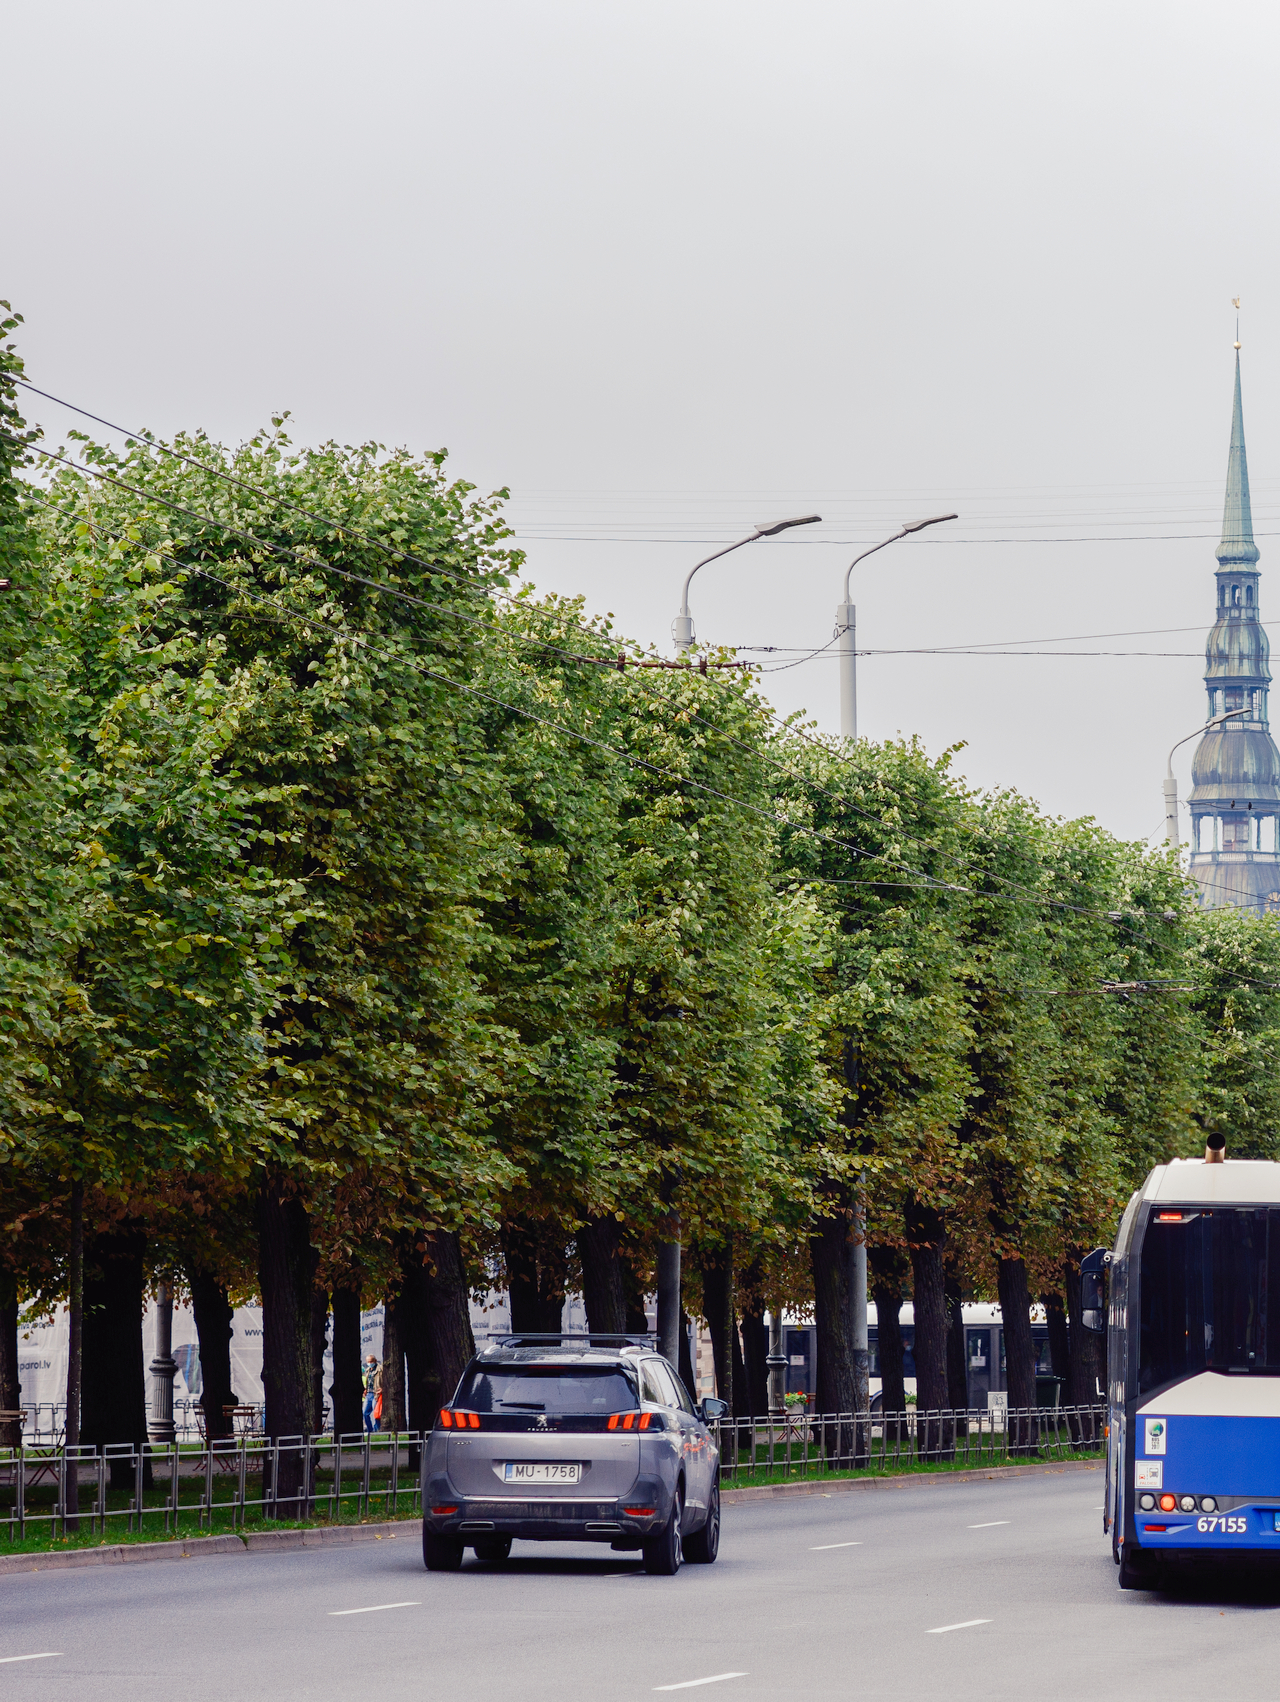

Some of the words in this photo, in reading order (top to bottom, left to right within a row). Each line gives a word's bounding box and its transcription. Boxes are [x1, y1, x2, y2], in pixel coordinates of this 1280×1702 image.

[18, 1360, 51, 1372] parol.lv
[515, 1466, 576, 1478] MU-1758
[1197, 1517, 1247, 1532] 67155
